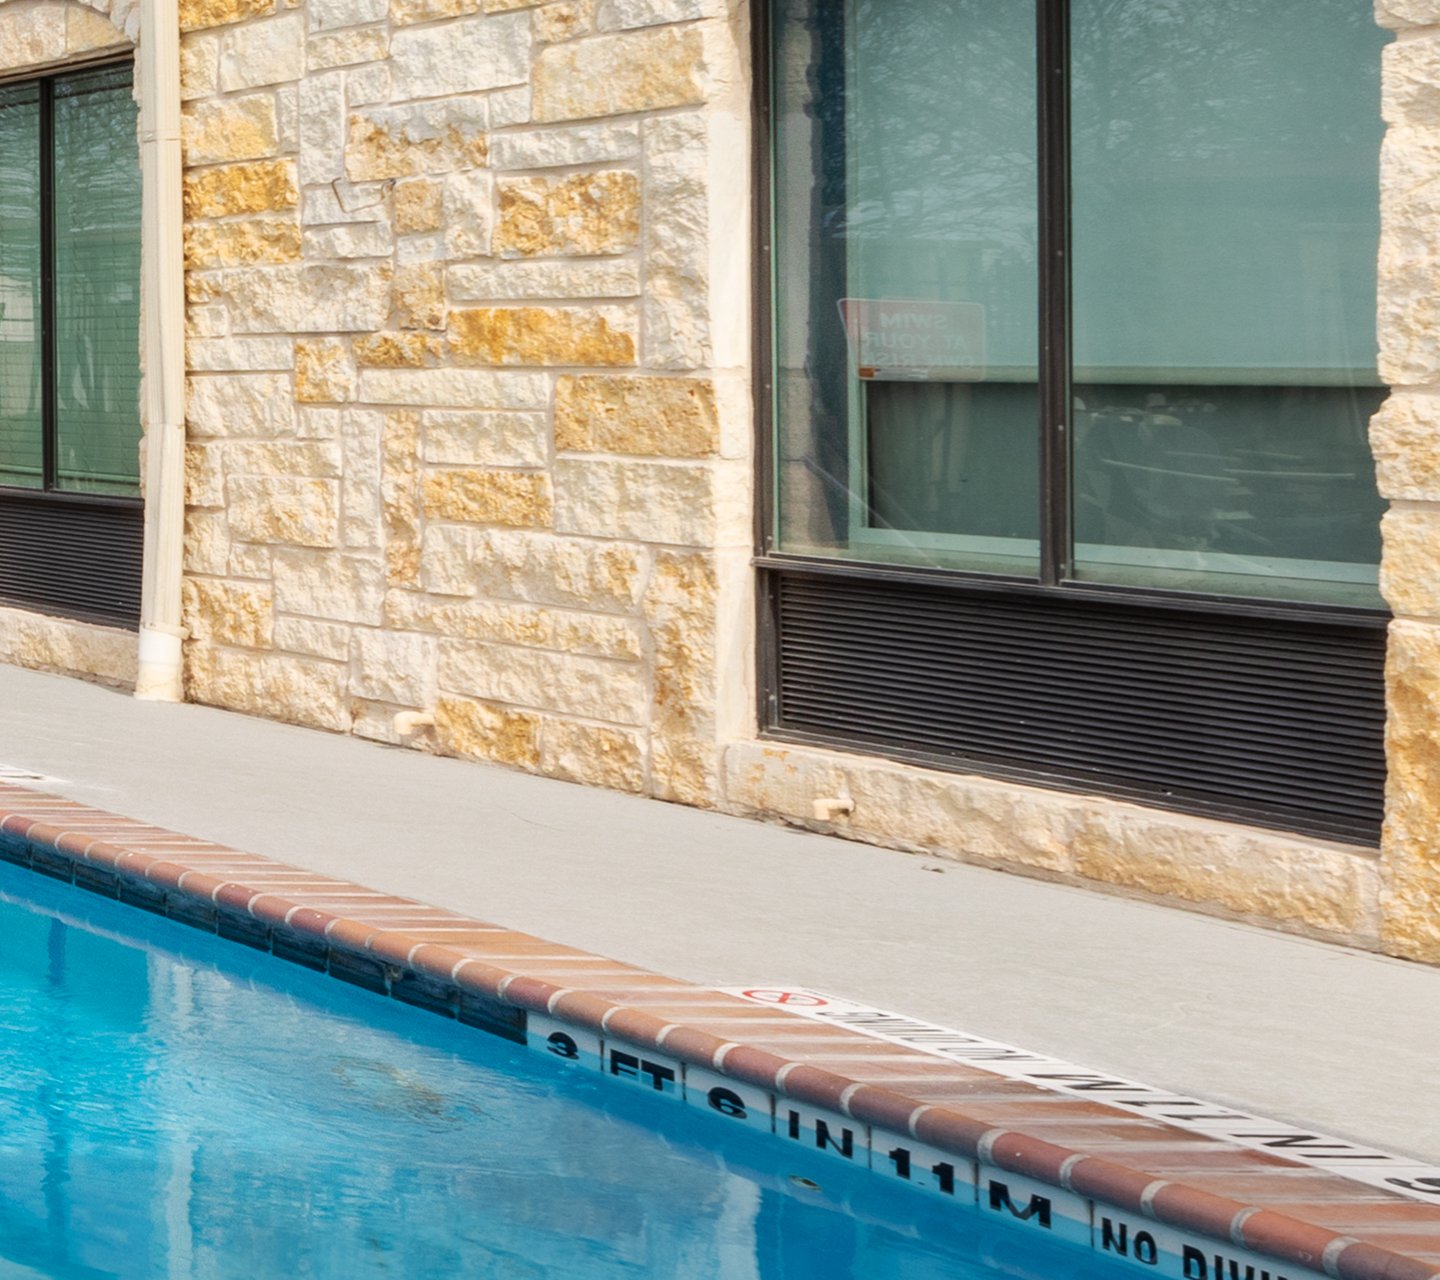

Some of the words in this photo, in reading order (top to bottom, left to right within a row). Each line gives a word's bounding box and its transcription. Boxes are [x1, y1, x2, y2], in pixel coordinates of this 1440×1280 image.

[546, 1032, 579, 1060] 3
[610, 1048, 675, 1091] FT
[707, 1086, 747, 1119] 6
[788, 1109, 853, 1159] IN
[989, 1179, 1051, 1230] M
[1102, 1217, 1158, 1265] NO
